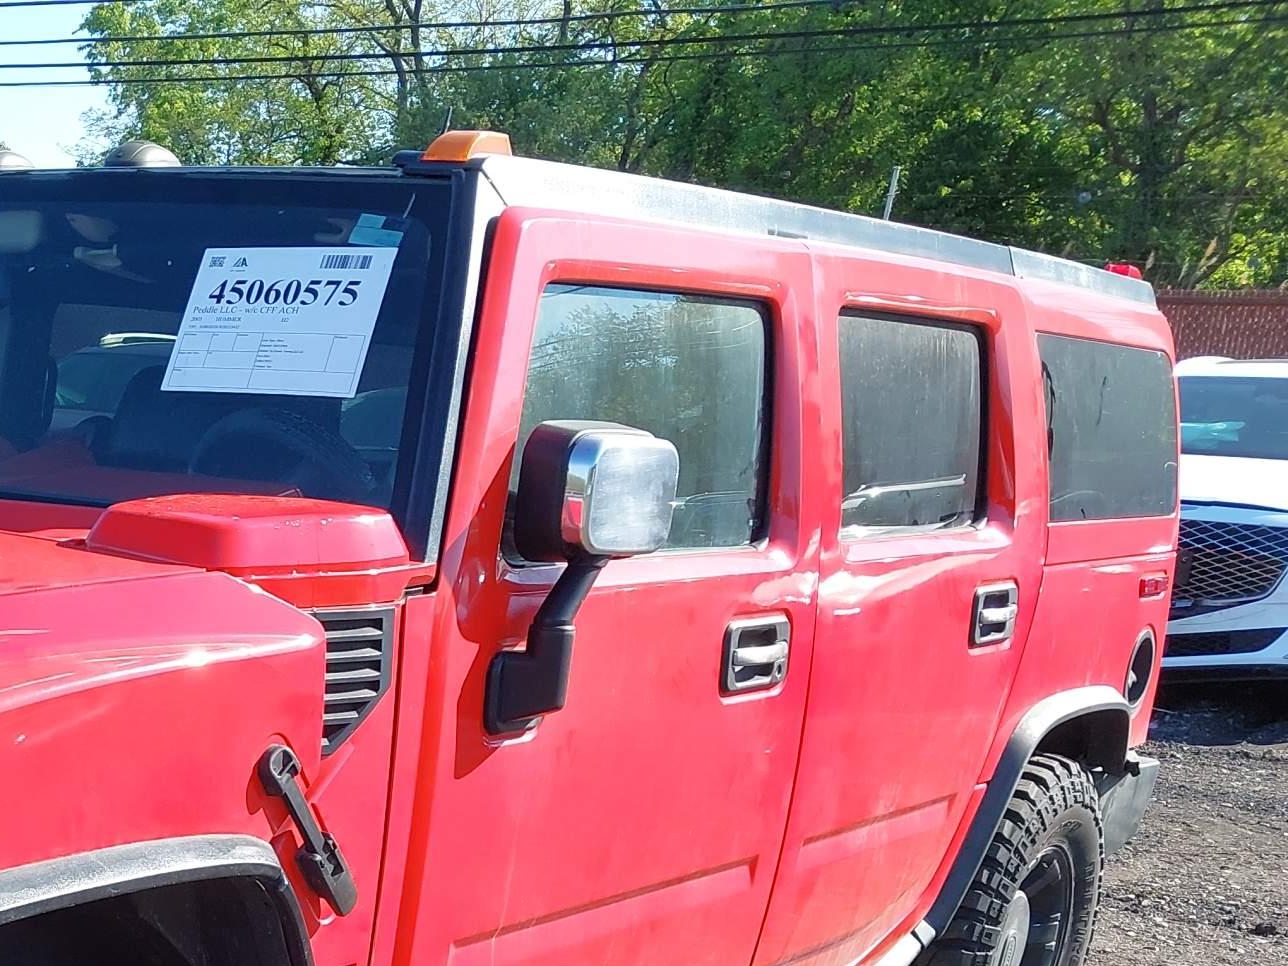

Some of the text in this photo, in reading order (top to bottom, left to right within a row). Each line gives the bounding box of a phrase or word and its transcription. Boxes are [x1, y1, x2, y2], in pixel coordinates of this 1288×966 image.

[208, 279, 362, 306] 45060575
[193, 306, 218, 314] Peddle
[220, 306, 238, 314] LLC
[244, 306, 258, 314] w/c
[278, 306, 300, 315] ACH
